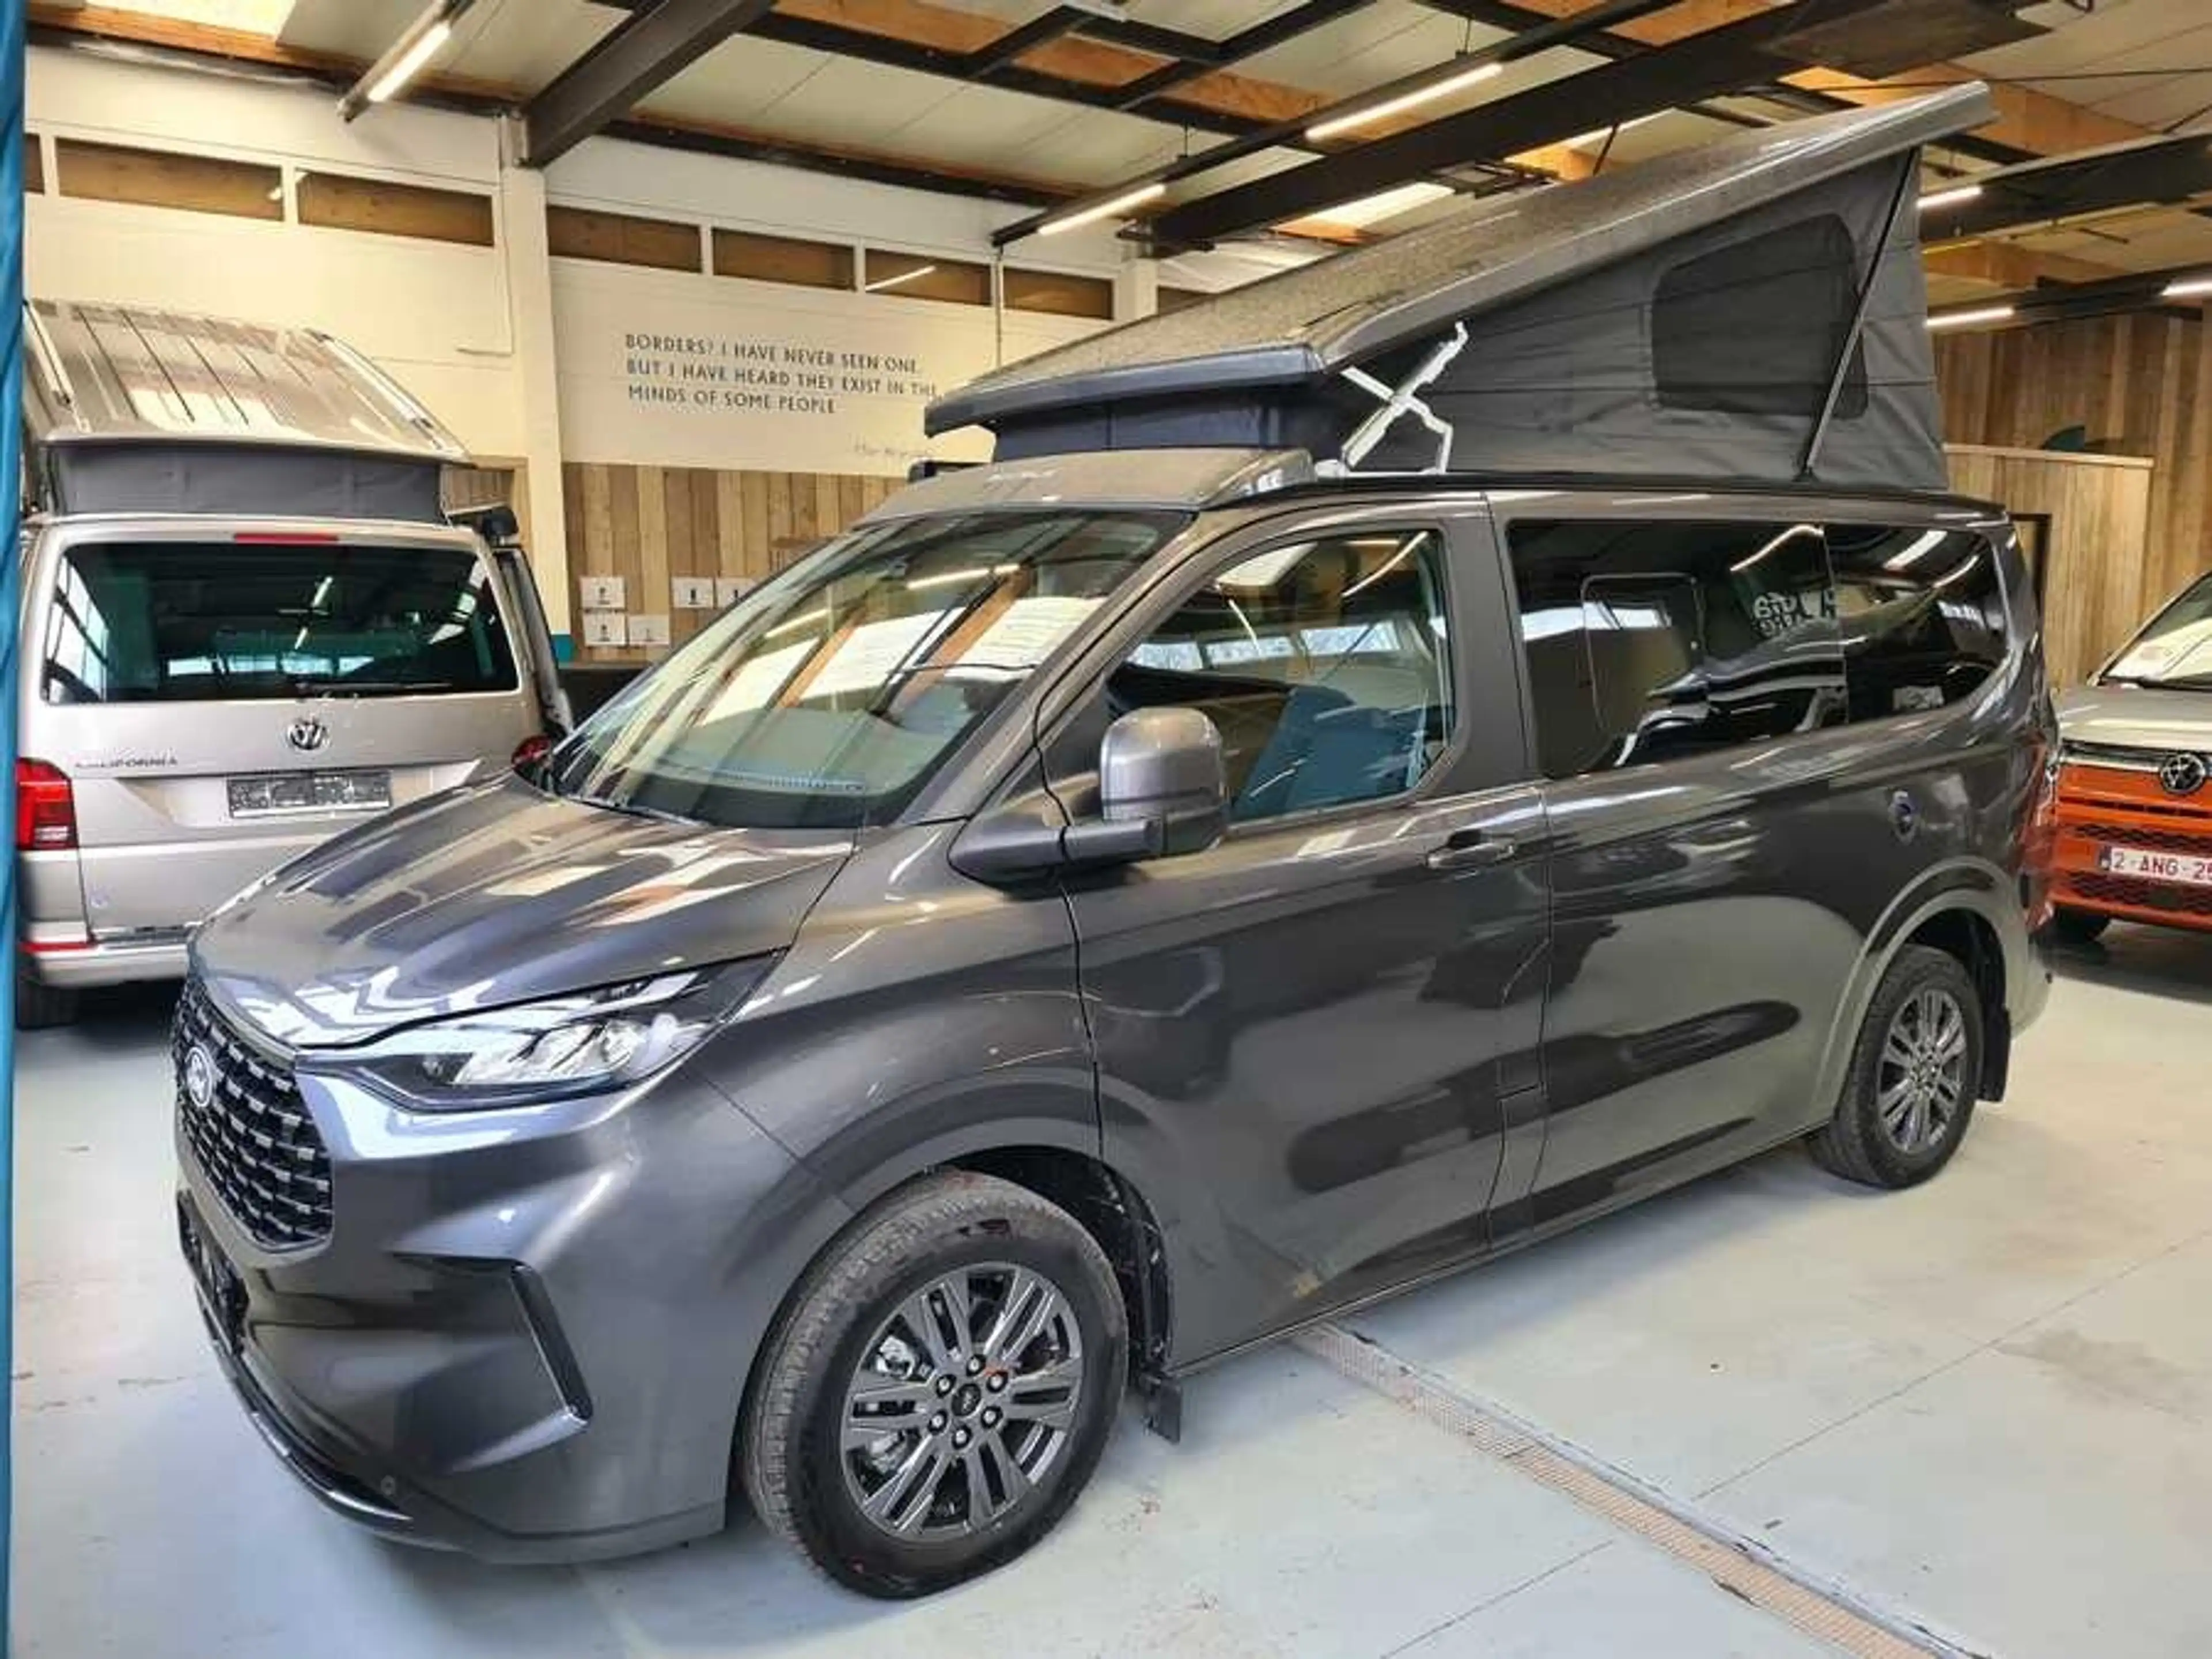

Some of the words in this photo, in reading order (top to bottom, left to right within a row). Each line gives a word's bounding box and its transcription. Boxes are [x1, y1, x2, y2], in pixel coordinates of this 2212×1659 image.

[626, 334, 714, 355] BORDERS?
[734, 342, 776, 362] HAVE
[784, 349, 834, 366] NEVER
[841, 353, 878, 370] SEEN
[627, 358, 661, 375] BUT
[683, 363, 727, 381] HAVE
[735, 369, 790, 387] HEARD
[798, 374, 834, 391] THEY
[842, 377, 881, 395] EXIST
[887, 380, 903, 395] IN
[628, 384, 686, 402] MINDS
[693, 388, 718, 404] OF
[724, 392, 771, 410] SOME
[779, 395, 835, 414] PEOPLE
